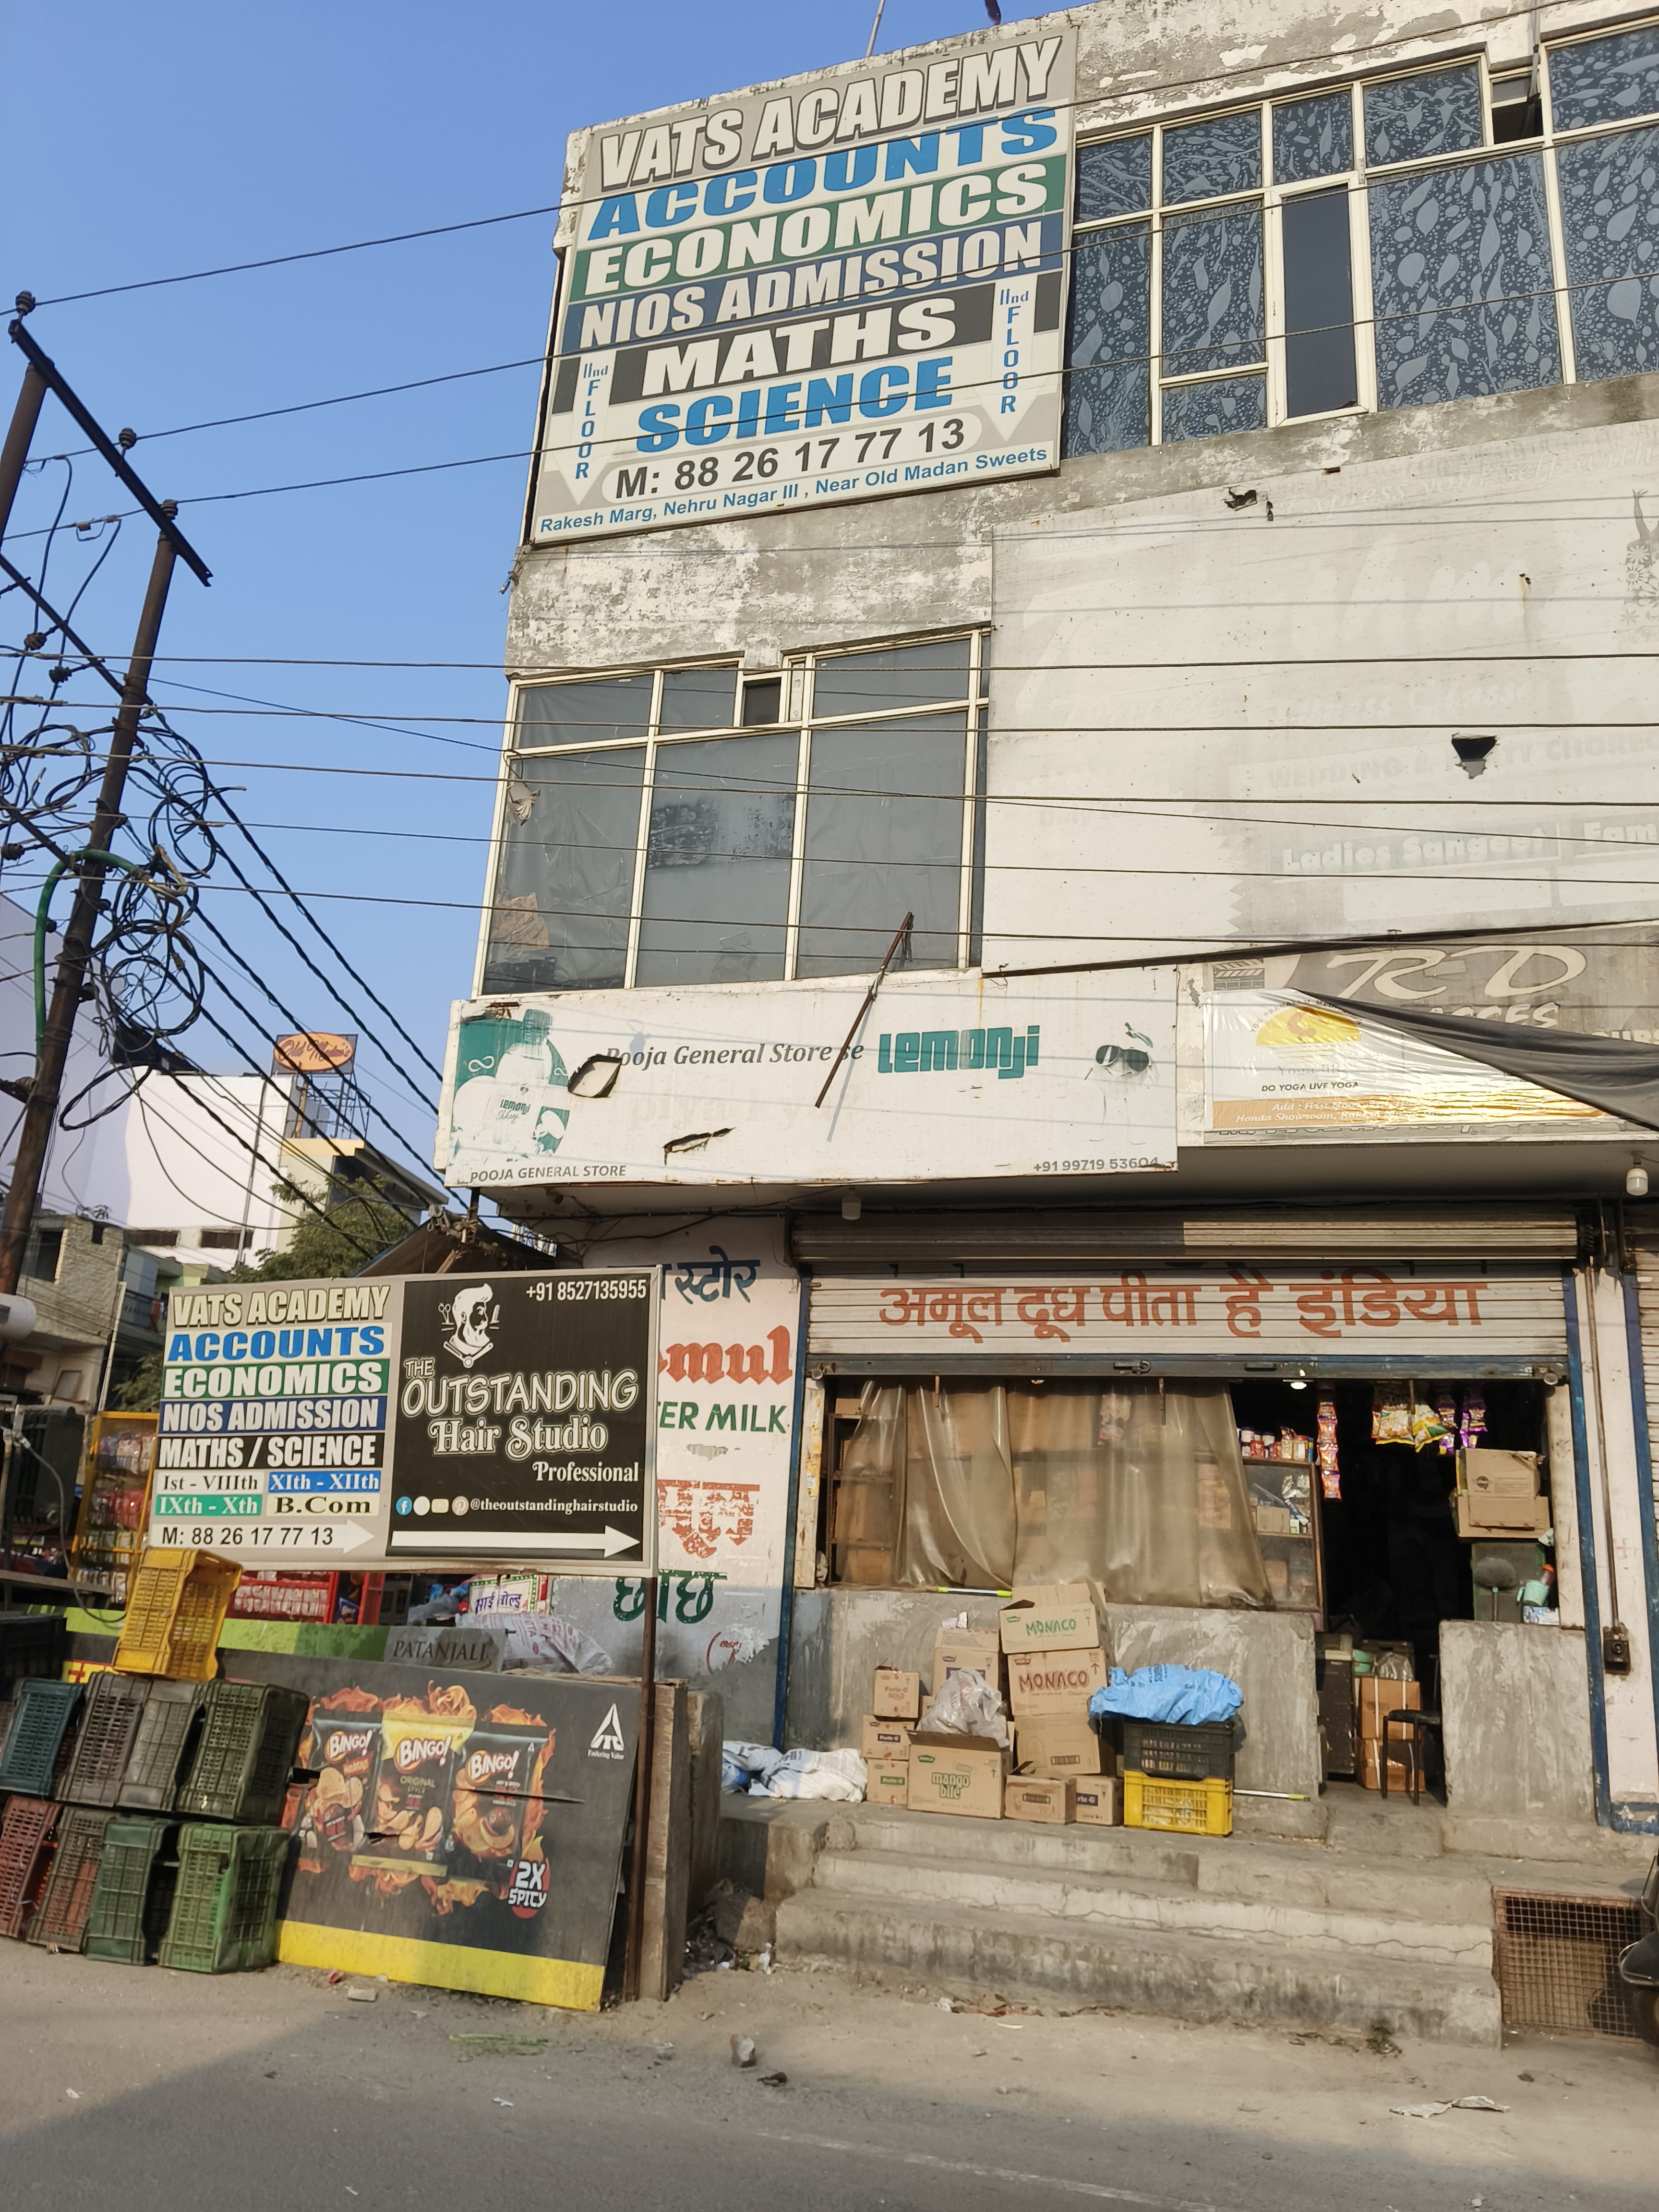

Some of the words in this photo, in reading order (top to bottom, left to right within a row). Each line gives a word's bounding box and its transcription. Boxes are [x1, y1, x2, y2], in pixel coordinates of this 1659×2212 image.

[601, 108, 743, 191] VATS
[751, 36, 1063, 161] ACADEMY
[588, 107, 1057, 241] ACCOUNTS
[585, 163, 1047, 296] ECONOMICS
[580, 286, 704, 348] NIOS
[716, 219, 1042, 324] ADMISSION
[641, 297, 956, 396] MATHS
[636, 355, 953, 453] SCIENCE
[615, 467, 660, 499] M:
[674, 457, 719, 491] 88
[733, 447, 778, 481] 26
[794, 438, 841, 471] 17
[855, 427, 902, 461] 77
[918, 418, 965, 452] 13
[540, 510, 604, 533] Rakesh
[610, 505, 657, 525] Marg,
[663, 495, 718, 517] Nehru
[723, 488, 777, 511] Nagar
[815, 474, 860, 495] Near
[864, 469, 898, 488] Old
[904, 457, 969, 482] Madan
[974, 445, 1047, 472] Sweets
[1283, 842, 1391, 867] Ladies
[1402, 828, 1545, 863] Sangeet
[674, 1044, 762, 1065] General
[769, 1044, 832, 1063] Store
[1236, 1114, 1271, 1123] Honda
[470, 1168, 514, 1182] POOJA
[518, 1166, 579, 1178] GENERAL
[583, 1165, 626, 1177] STORE
[1034, 1161, 1058, 1172] +91
[1063, 1159, 1105, 1171] 99719
[675, 1245, 761, 1304] स्टोर
[526, 1282, 552, 1301] +91
[557, 1279, 647, 1300] 8527135955
[879, 1287, 1006, 1344] अमूल
[1014, 1287, 1091, 1343] दूध
[1100, 1270, 1202, 1327] पीता
[1289, 1266, 1488, 1337] इंडिया
[173, 1293, 242, 1327] VATS
[247, 1286, 390, 1325] ACADEMY
[168, 1326, 385, 1361] ACCOUNTS
[659, 1325, 793, 1385] mul
[164, 1362, 382, 1398] ECONOMICS
[405, 1358, 433, 1378] THE
[402, 1369, 639, 1418] OUTSTANDING
[162, 1402, 223, 1431] NIOS
[228, 1398, 378, 1431] ADMISSION
[705, 1404, 787, 1433] MILK
[159, 1438, 243, 1467] MATHS
[267, 1435, 376, 1467] SCIENCE
[429, 1419, 500, 1455] Hair
[505, 1415, 608, 1460] Studio
[532, 1461, 639, 1482] Professional
[222, 1496, 258, 1514] Xth
[276, 1497, 371, 1514] B.Com
[470, 1498, 638, 1515] @theoutstandinghairstudio
[162, 1527, 184, 1544] M:
[192, 1527, 214, 1544] 88
[221, 1527, 243, 1544] 26
[251, 1527, 272, 1544] 17
[280, 1527, 302, 1544] 77
[311, 1527, 333, 1544] 13
[1026, 1619, 1076, 1636] MONACO
[393, 1640, 489, 1661] PATANJALI
[1020, 1670, 1090, 1694] MONACO
[330, 1730, 373, 1759] BINGO!
[399, 1736, 451, 1767] BINGO!
[471, 1750, 519, 1780] BINGO!
[932, 1772, 970, 1788] mango
[515, 1862, 546, 1890] 2X
[508, 1888, 547, 1908] SPICY
